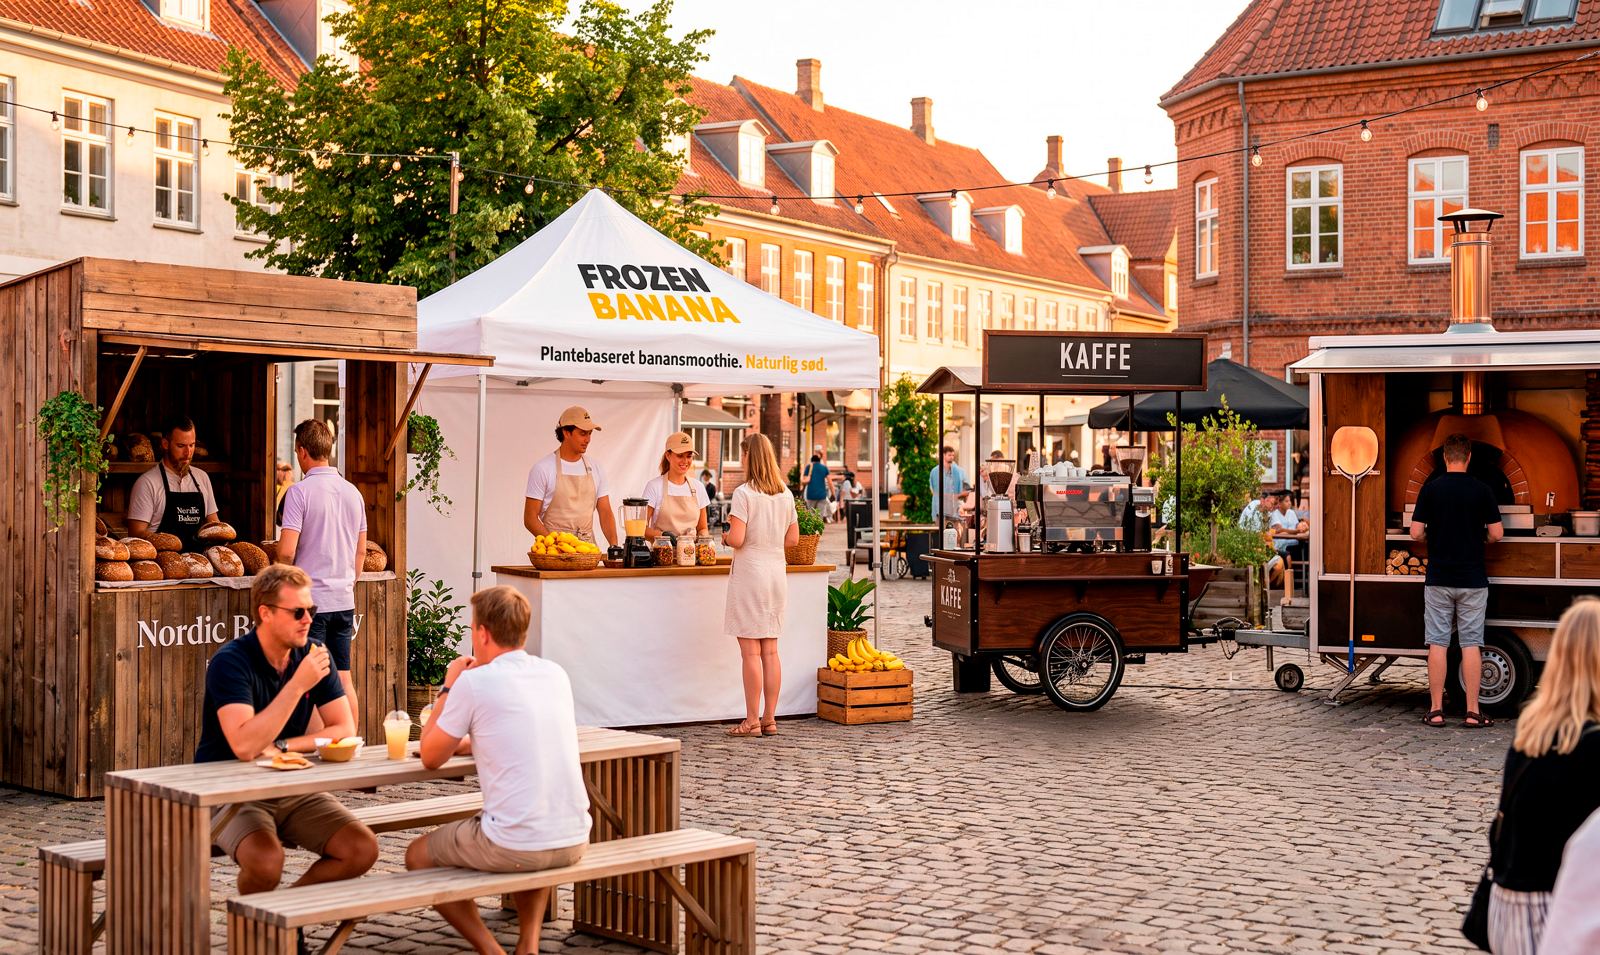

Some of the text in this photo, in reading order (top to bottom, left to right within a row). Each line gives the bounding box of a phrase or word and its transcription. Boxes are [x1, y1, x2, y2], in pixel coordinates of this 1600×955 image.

[577, 264, 711, 292] FROZEN
[587, 293, 741, 323] BANANA
[540, 346, 828, 374] Plantebaseret banansmoothie. Naturlig sød.
[1060, 342, 1131, 370] KAFFE
[177, 514, 201, 524] Bakery
[940, 584, 962, 610] KAFFE
[137, 615, 227, 648] Nordic
